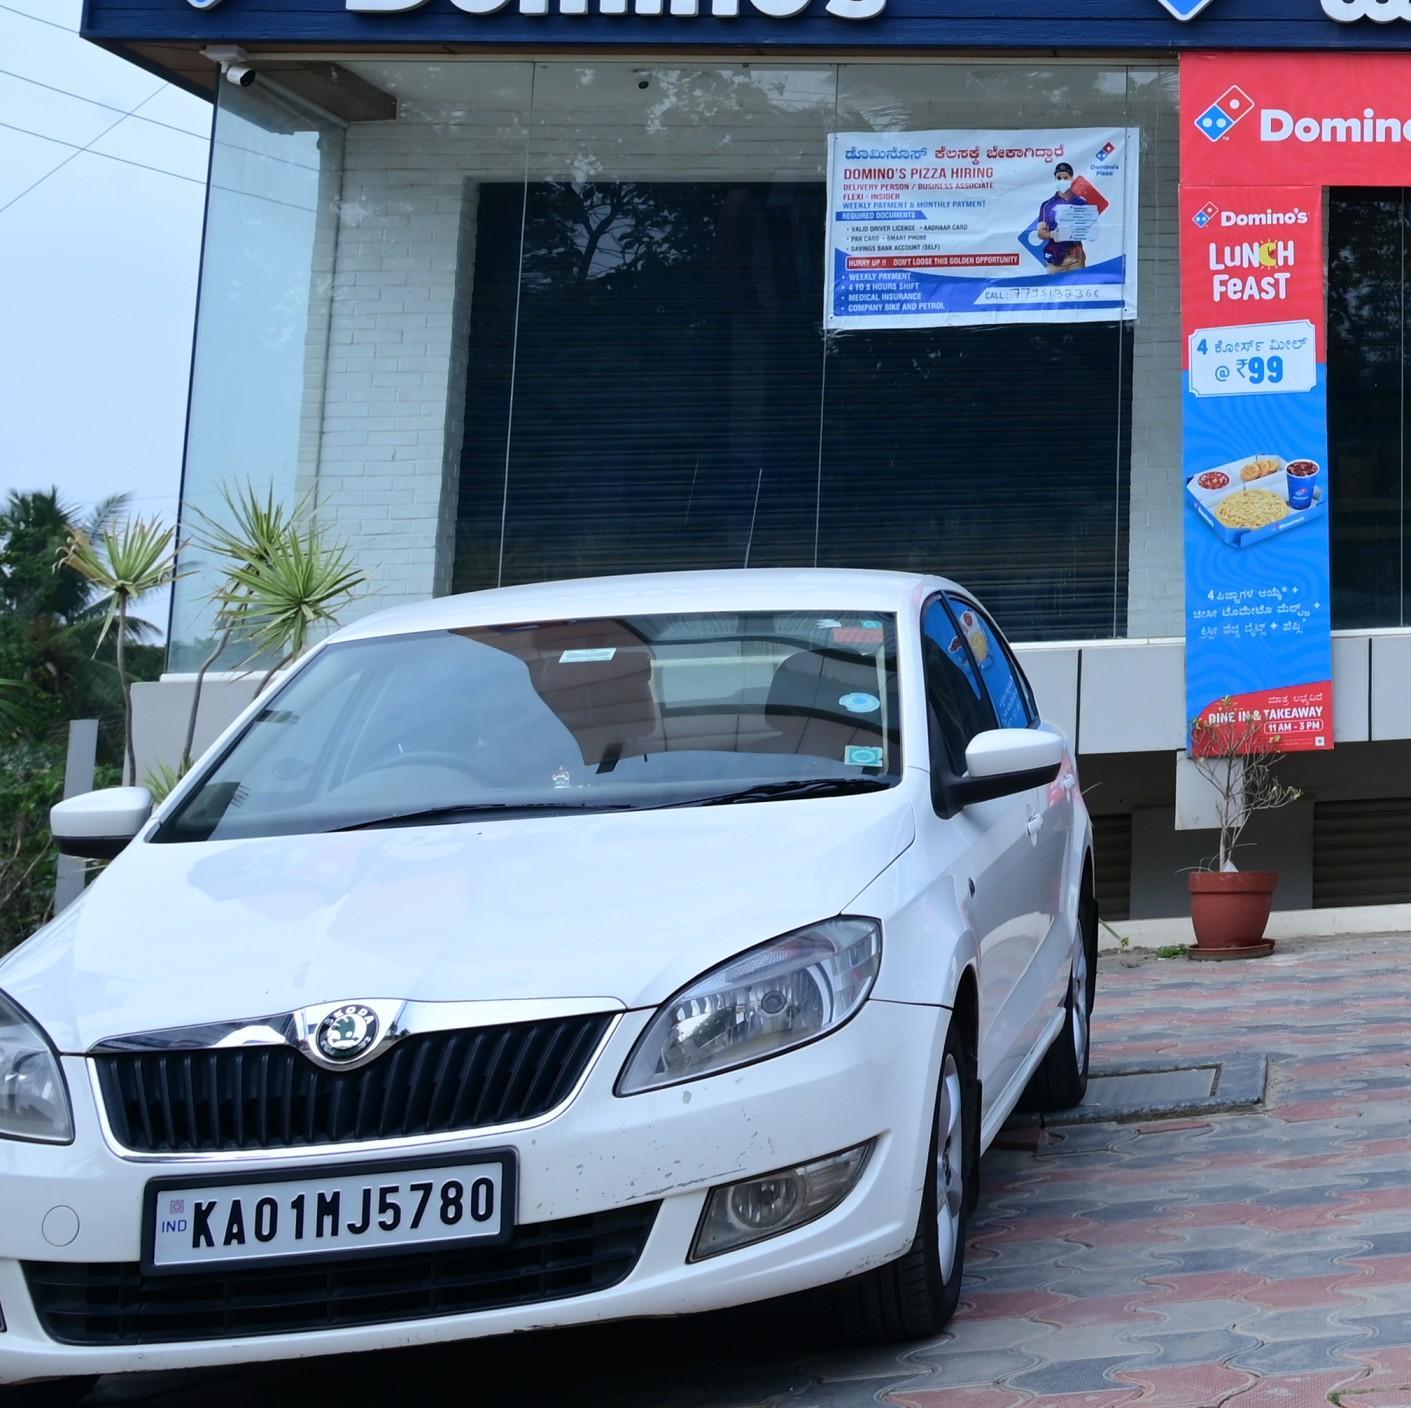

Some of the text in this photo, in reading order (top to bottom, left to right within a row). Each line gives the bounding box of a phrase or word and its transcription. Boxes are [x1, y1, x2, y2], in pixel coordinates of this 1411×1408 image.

[843, 166, 994, 180] DOMINO'S PIZZA HIRING
[843, 183, 878, 191] DELIVERY
[917, 182, 953, 190] BUSINESS
[955, 181, 995, 189] ASSOCIATE
[843, 193, 864, 201] FLEXI
[842, 200, 986, 209] WEEKLY PAYMENT MONTHLY PAYMENT
[842, 211, 916, 220] REQUIRED DOCUMENTS
[1221, 208, 1308, 227] Domino's
[848, 259, 870, 267] HURRY
[934, 257, 948, 265] THIS
[975, 256, 1018, 264] OPPORTUNITY
[850, 272, 911, 281] WEEKLY PAYMENT
[872, 282, 920, 291] HOURS SHIFT
[849, 293, 880, 301] MEDICAL
[848, 304, 883, 312] COMPANY
[884, 303, 900, 311] BIKE
[918, 302, 945, 310] PETROL
[1196, 338, 1208, 355] 4
[1214, 355, 1284, 384] @ ₹99
[1208, 590, 1214, 600] 4
[1208, 706, 1323, 725] DINE IN & TAKEAWAY
[1268, 724, 1277, 732] 11
[1279, 723, 1291, 731] AM
[1307, 722, 1320, 730] PM
[192, 1176, 496, 1249] KA01MJ5780
[161, 1218, 188, 1234] IND
